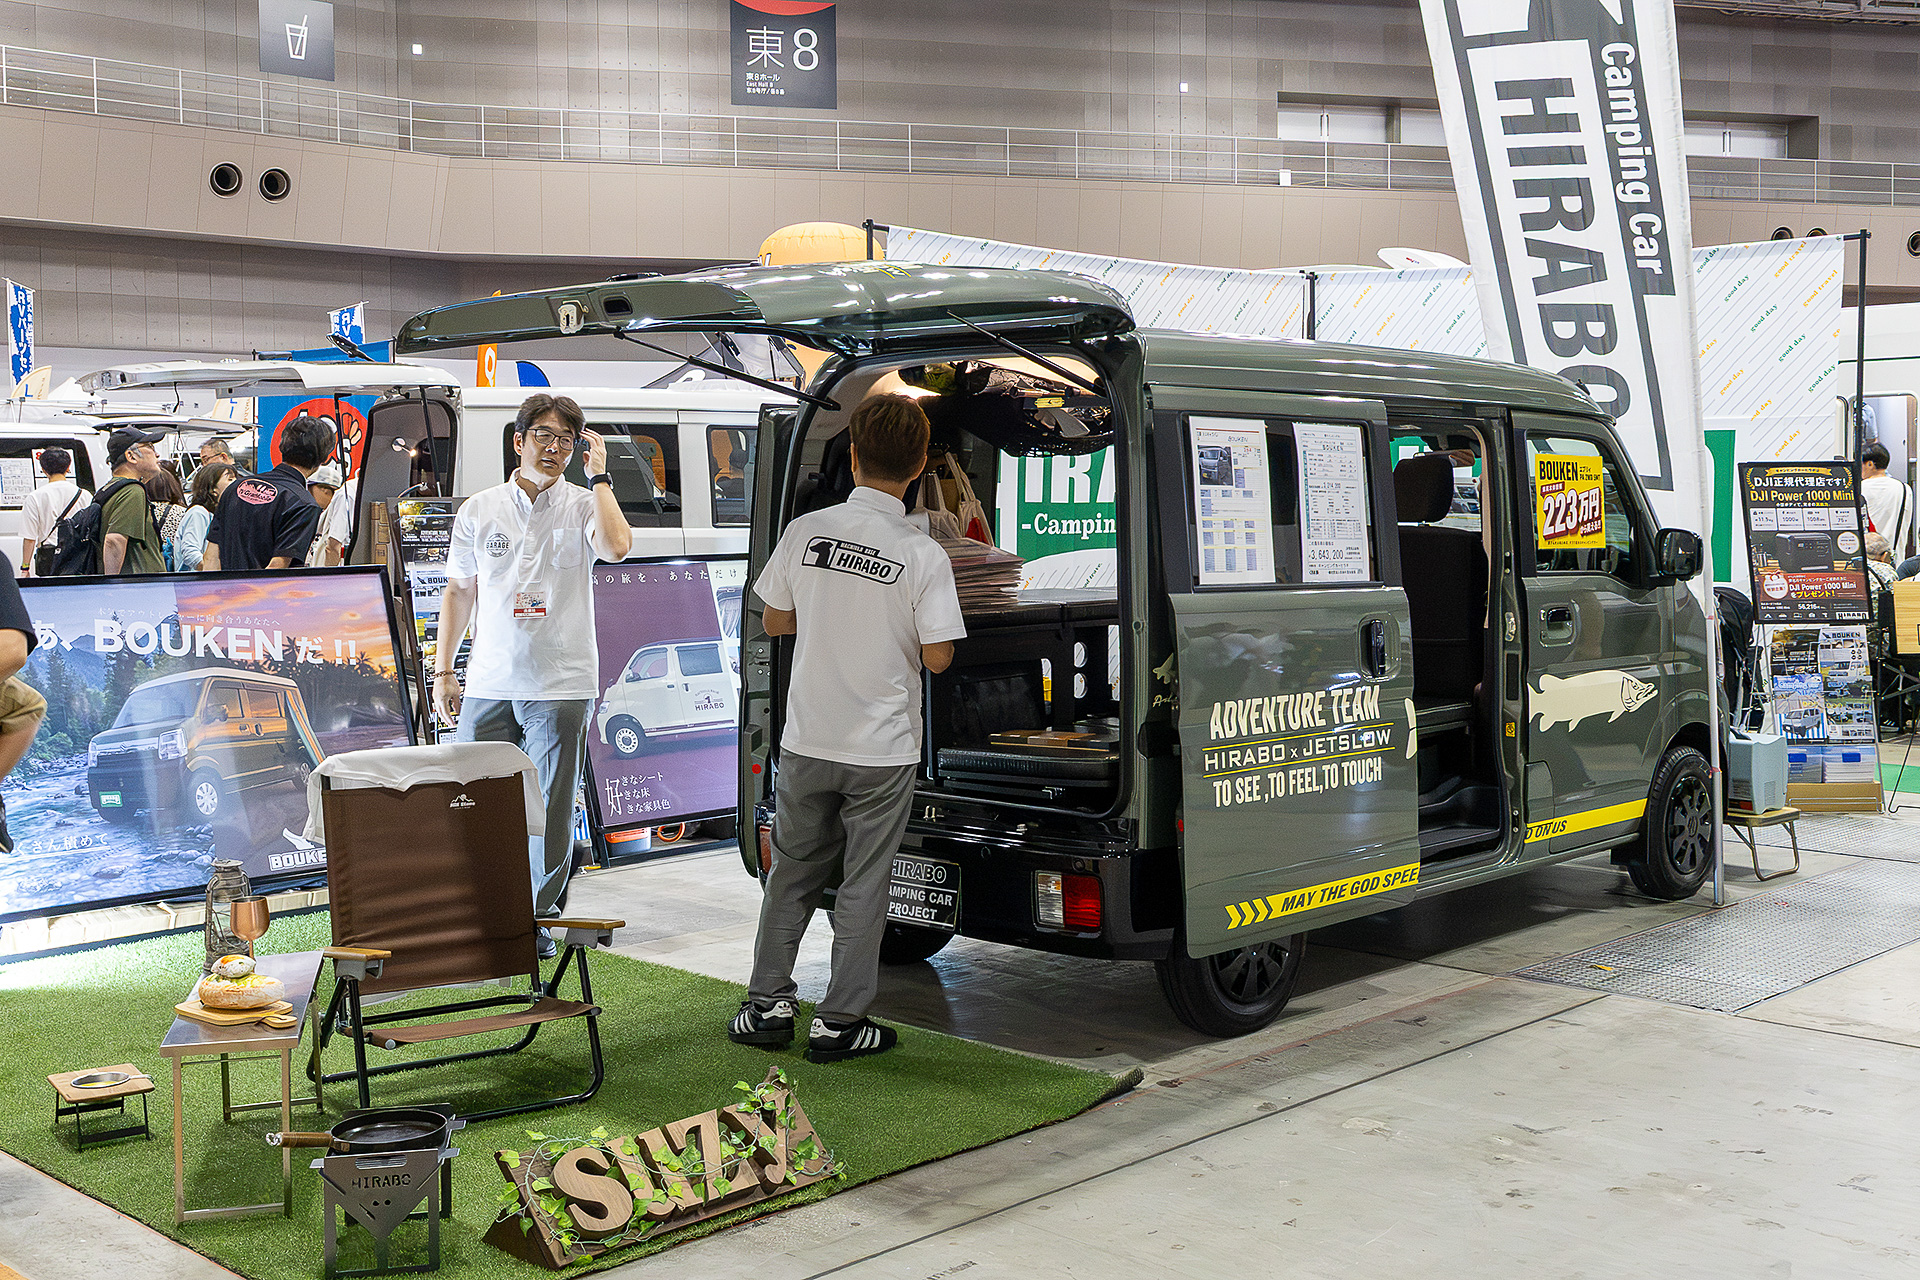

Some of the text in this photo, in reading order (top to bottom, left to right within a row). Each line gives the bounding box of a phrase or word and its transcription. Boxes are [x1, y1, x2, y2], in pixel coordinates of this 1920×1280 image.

[745, 25, 820, 71] 東 8
[745, 72, 781, 81] 東8ホール
[1601, 42, 1663, 275] Camping Car
[1494, 77, 1632, 420] HIRABO
[1774, 240, 1808, 278] good travel
[1696, 256, 1711, 274] good
[1353, 285, 1373, 309] good day
[1422, 282, 1442, 307] good day
[1724, 274, 1750, 303] good day
[1803, 269, 1839, 308] good travel
[1376, 312, 1396, 336] good day
[1446, 309, 1467, 335] good day
[1750, 303, 1779, 333] good day
[1705, 338, 1718, 351] day
[1778, 333, 1807, 363] good day
[1720, 368, 1745, 396] good day
[1808, 363, 1836, 394] good day
[1760, 398, 1773, 411] day
[1774, 428, 1801, 458] good day
[1539, 460, 1579, 481] BOUKEN
[1753, 476, 1847, 487] DJI正規代理店です!
[1749, 489, 1855, 501] DJI Power 1000 Mini
[1542, 487, 1600, 537] 223万円
[485, 542, 510, 550] GARAGE
[836, 552, 893, 580] HIRABO
[1788, 584, 1801, 592] DJI
[1801, 583, 1822, 591] Power
[1823, 582, 1841, 590] 1000
[93, 618, 284, 663] BOUKEN
[296, 635, 324, 665] だ
[694, 702, 726, 712] HIRABO
[1209, 684, 1381, 741] ADVENTURE TEAM
[1204, 743, 1286, 772] HIRABO
[1302, 728, 1392, 757] JETSLOW
[1212, 779, 1232, 808] TO
[1235, 774, 1262, 805] SEE
[1342, 756, 1383, 787] TOUCH
[1551, 819, 1568, 834] US
[929, 892, 953, 907] CAR
[1280, 867, 1420, 913] MAY THE GOD SPEE
[888, 901, 938, 920] PROJECT
[351, 1173, 412, 1189] HIRABO
